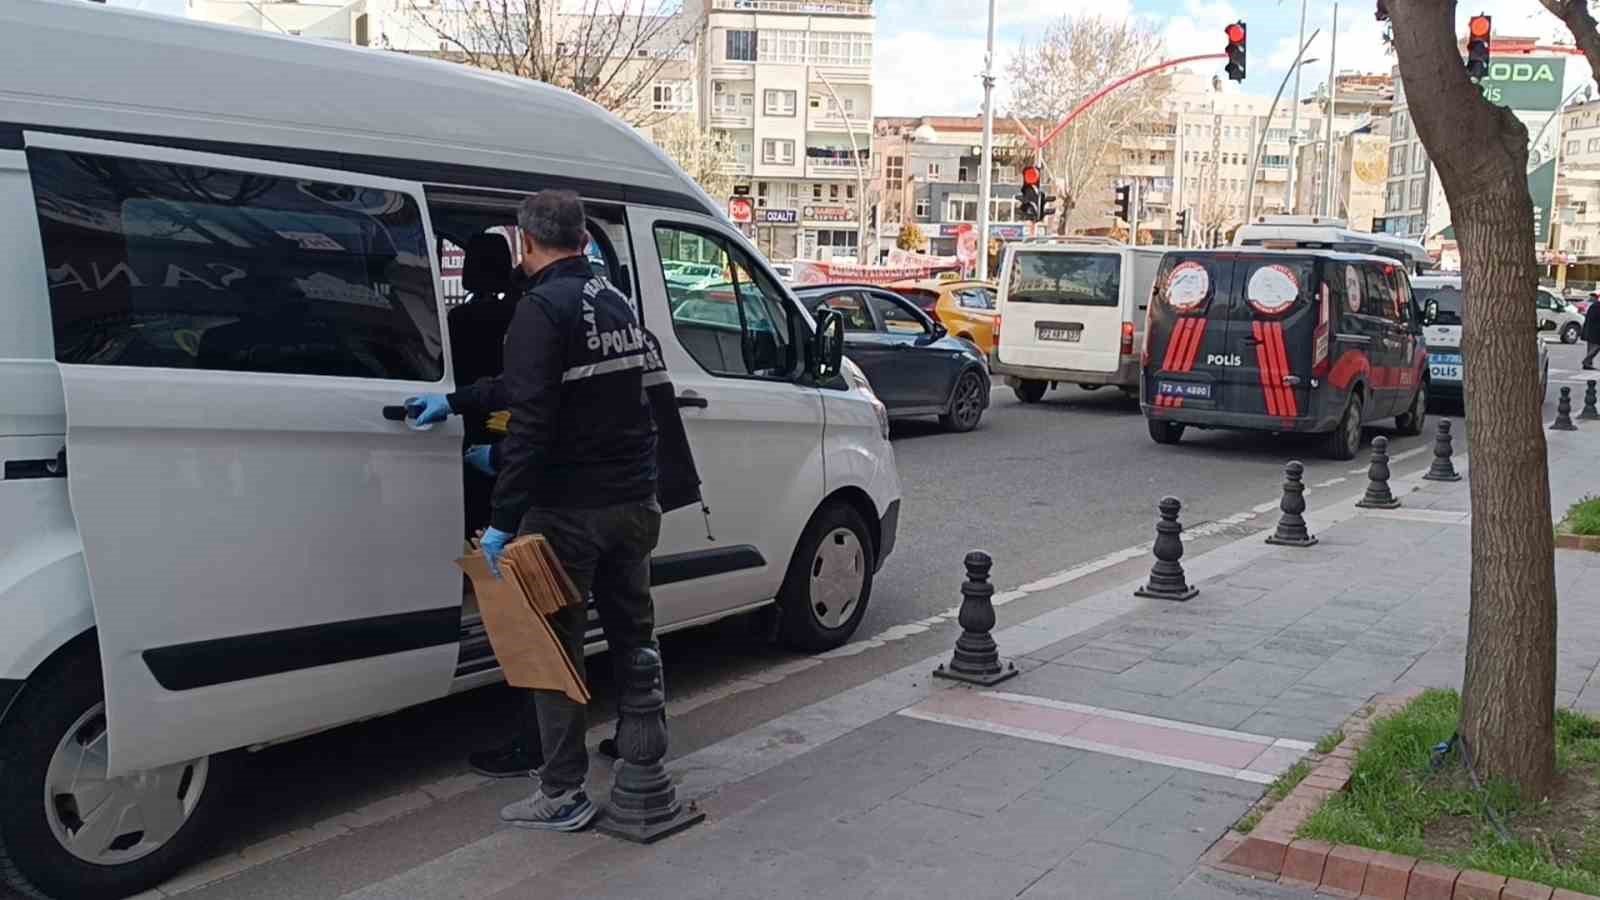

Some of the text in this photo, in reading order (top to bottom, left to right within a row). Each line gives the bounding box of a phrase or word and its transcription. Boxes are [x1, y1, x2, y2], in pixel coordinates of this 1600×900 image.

[1491, 63, 1554, 81] ODA
[600, 322, 643, 356] POLİS
[1207, 352, 1241, 366] POLİS
[1431, 366, 1457, 377] OLİS
